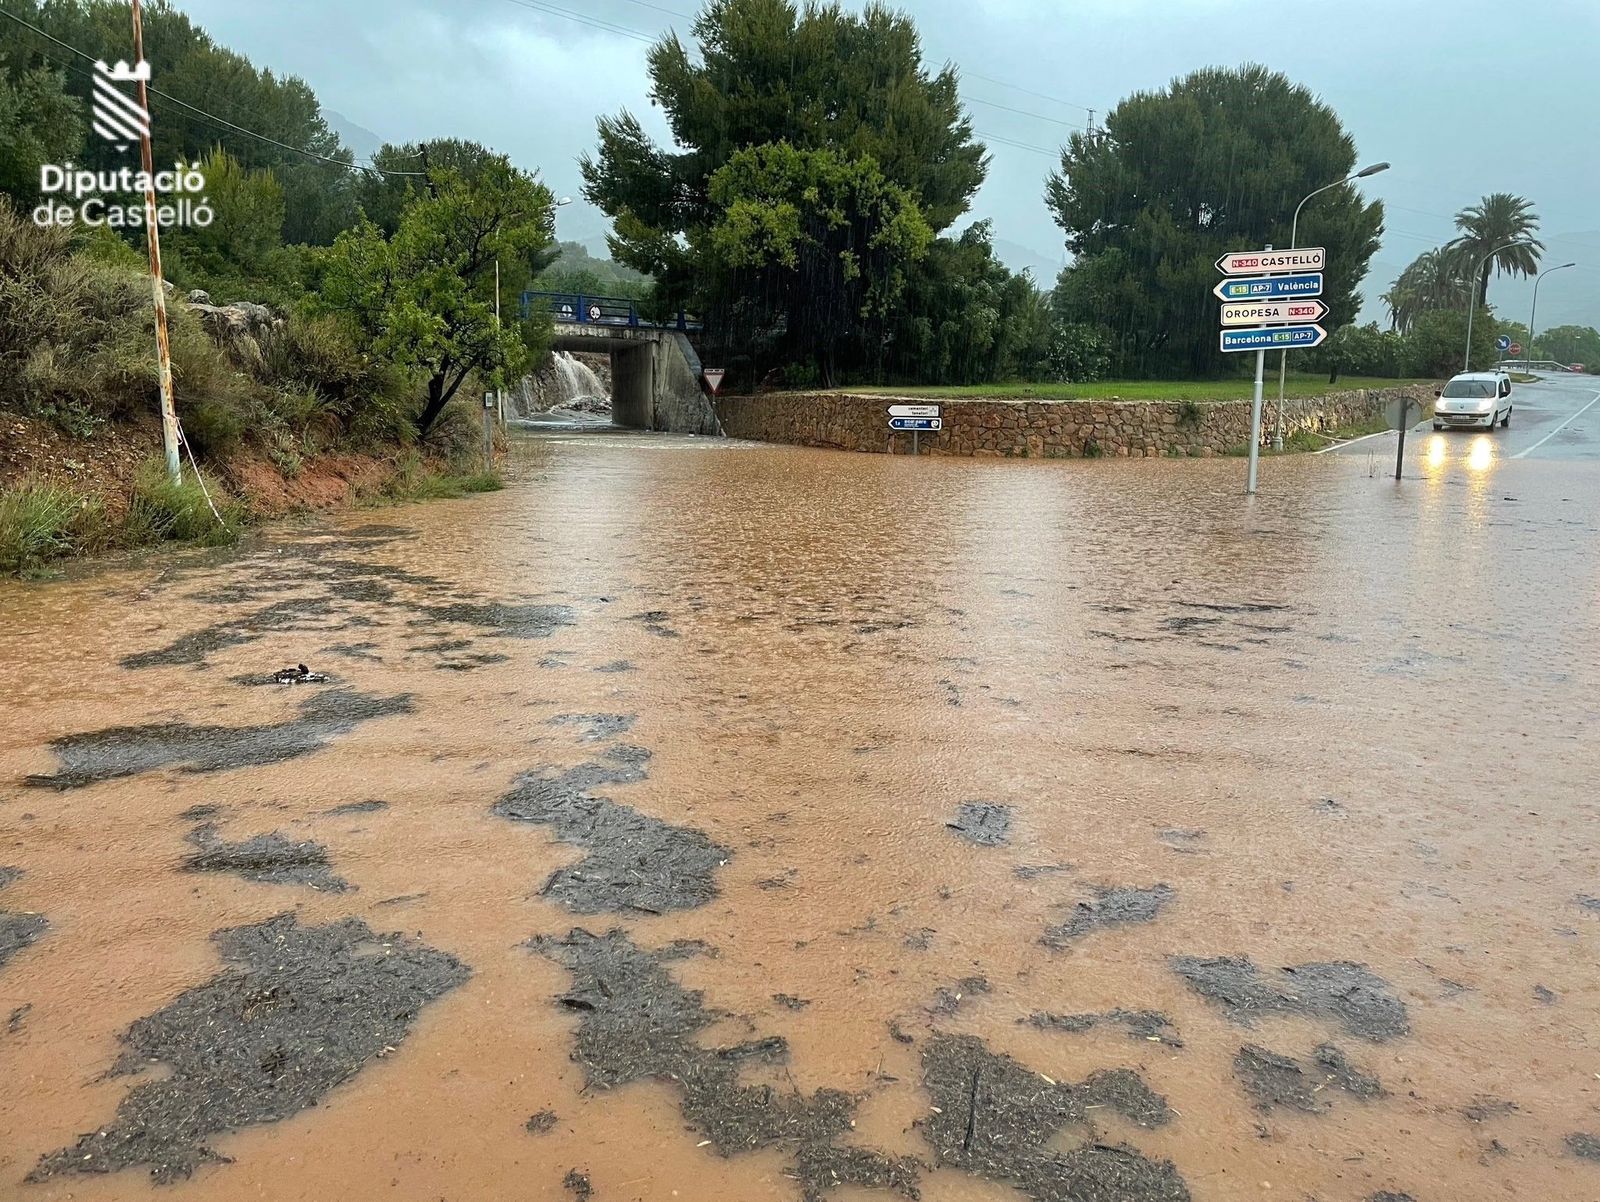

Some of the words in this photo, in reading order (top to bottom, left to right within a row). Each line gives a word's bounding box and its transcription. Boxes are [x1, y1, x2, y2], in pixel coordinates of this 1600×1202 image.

[1232, 259, 1258, 267] N-340
[1261, 253, 1321, 266] CASTELLÓ
[1230, 285, 1247, 294] E-15
[1278, 281, 1319, 291] València
[1225, 308, 1280, 318] OROPESA
[1289, 307, 1314, 315] N-340
[1225, 335, 1272, 345] Barcelona
[1274, 333, 1290, 341] E-15
